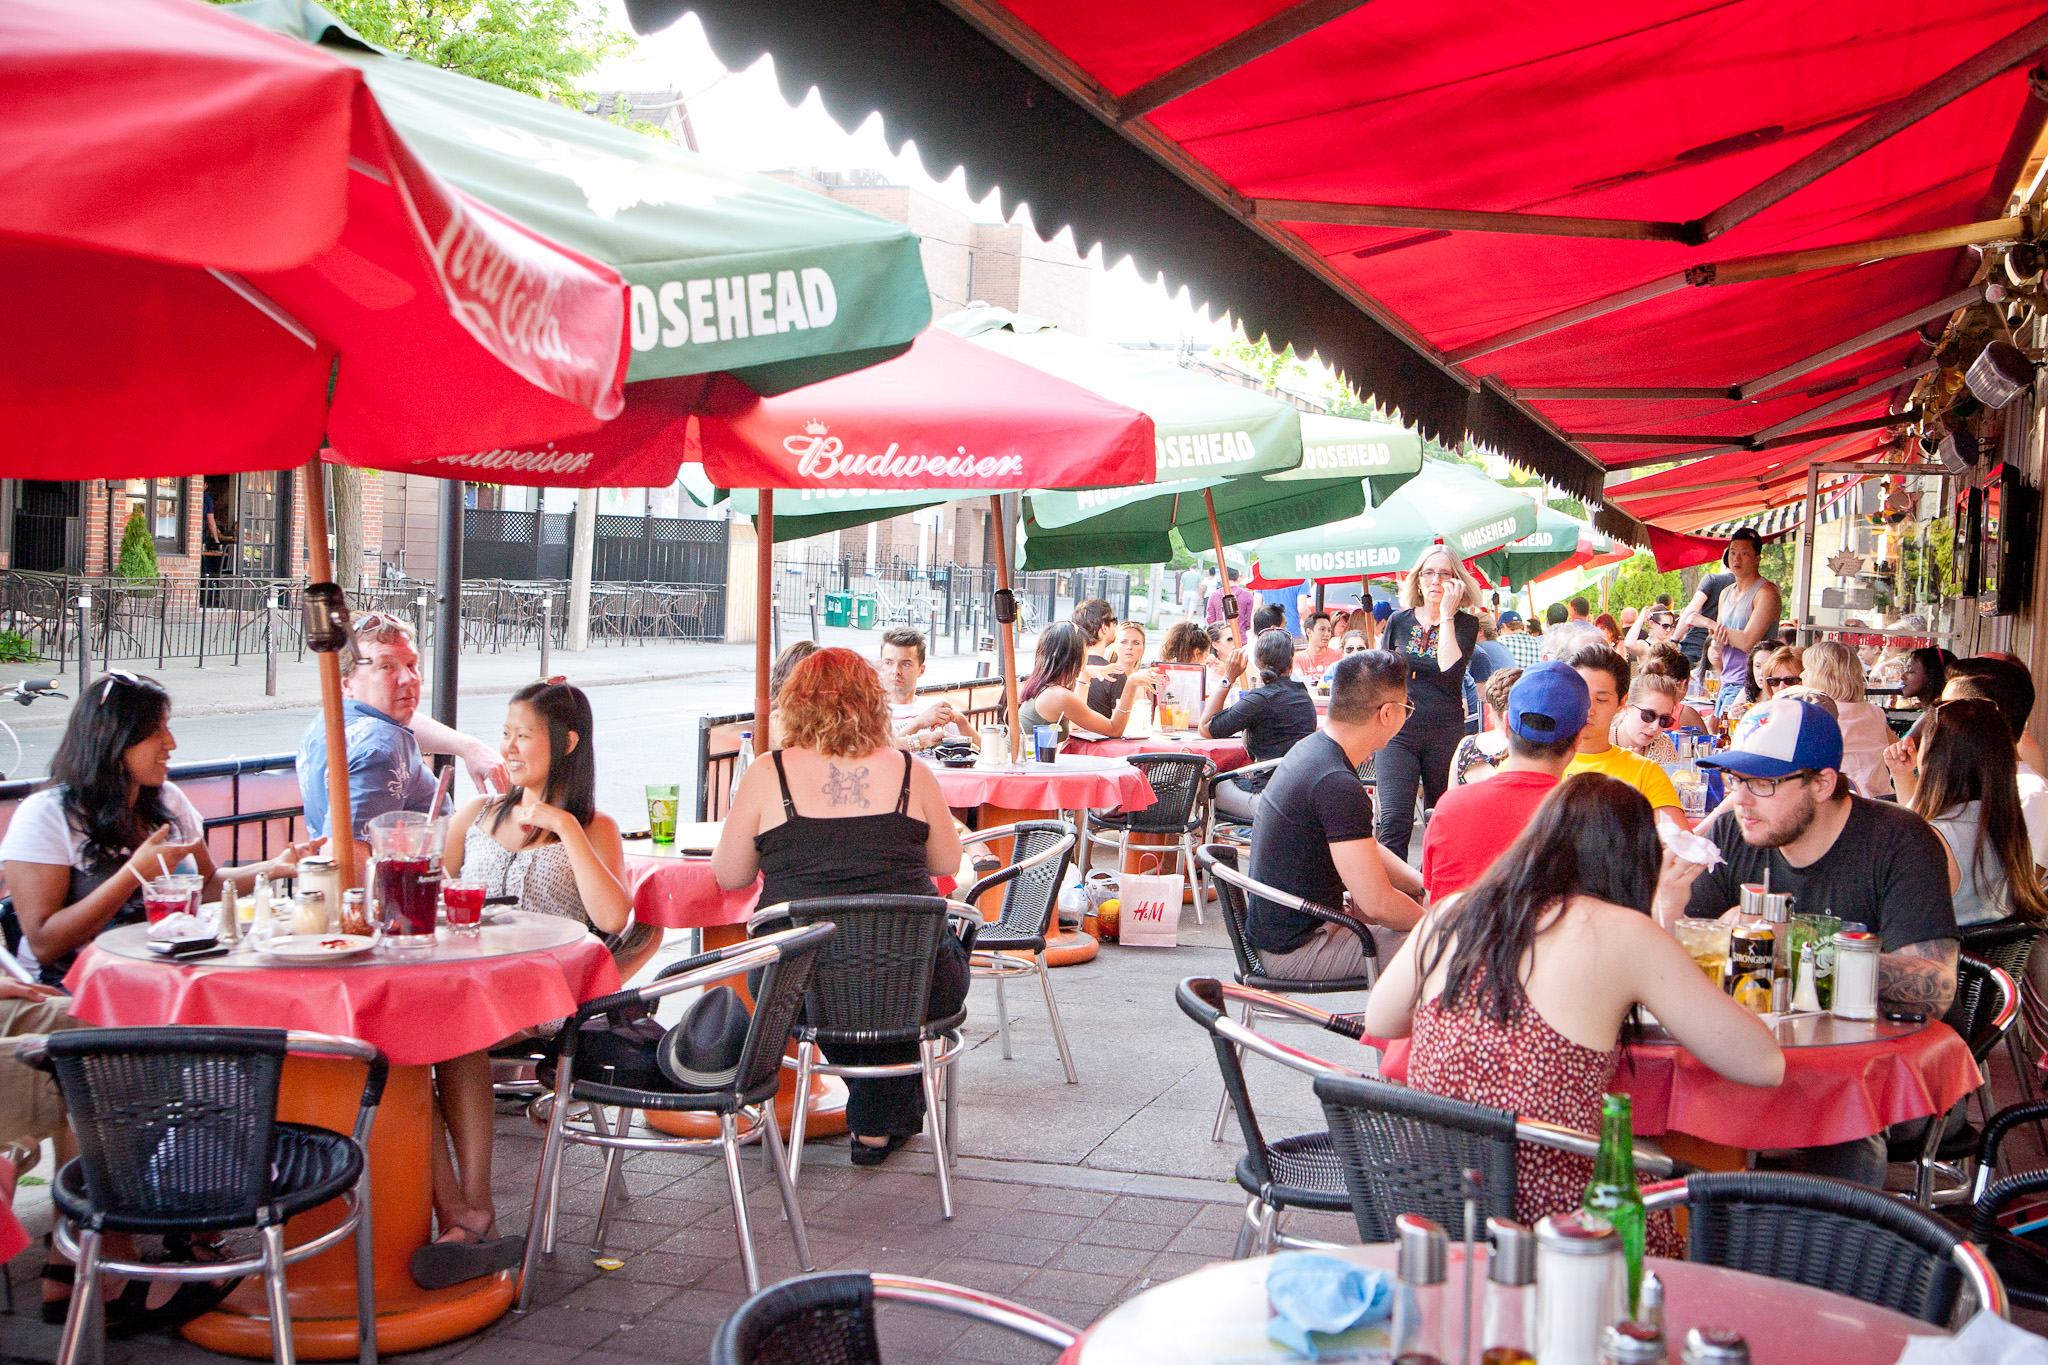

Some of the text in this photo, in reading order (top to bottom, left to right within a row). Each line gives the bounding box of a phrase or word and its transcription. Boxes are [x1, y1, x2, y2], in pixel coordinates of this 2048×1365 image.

[632, 267, 838, 351] OSEHEAD
[783, 436, 1023, 479] Budweiser
[1155, 431, 1256, 469] OSEHEAD
[1302, 443, 1390, 470] OOSEHEAD
[1461, 517, 1517, 550] MOOSEHEAD
[1295, 547, 1401, 572] MOOSEHEAD
[1133, 901, 1165, 922] H&M
